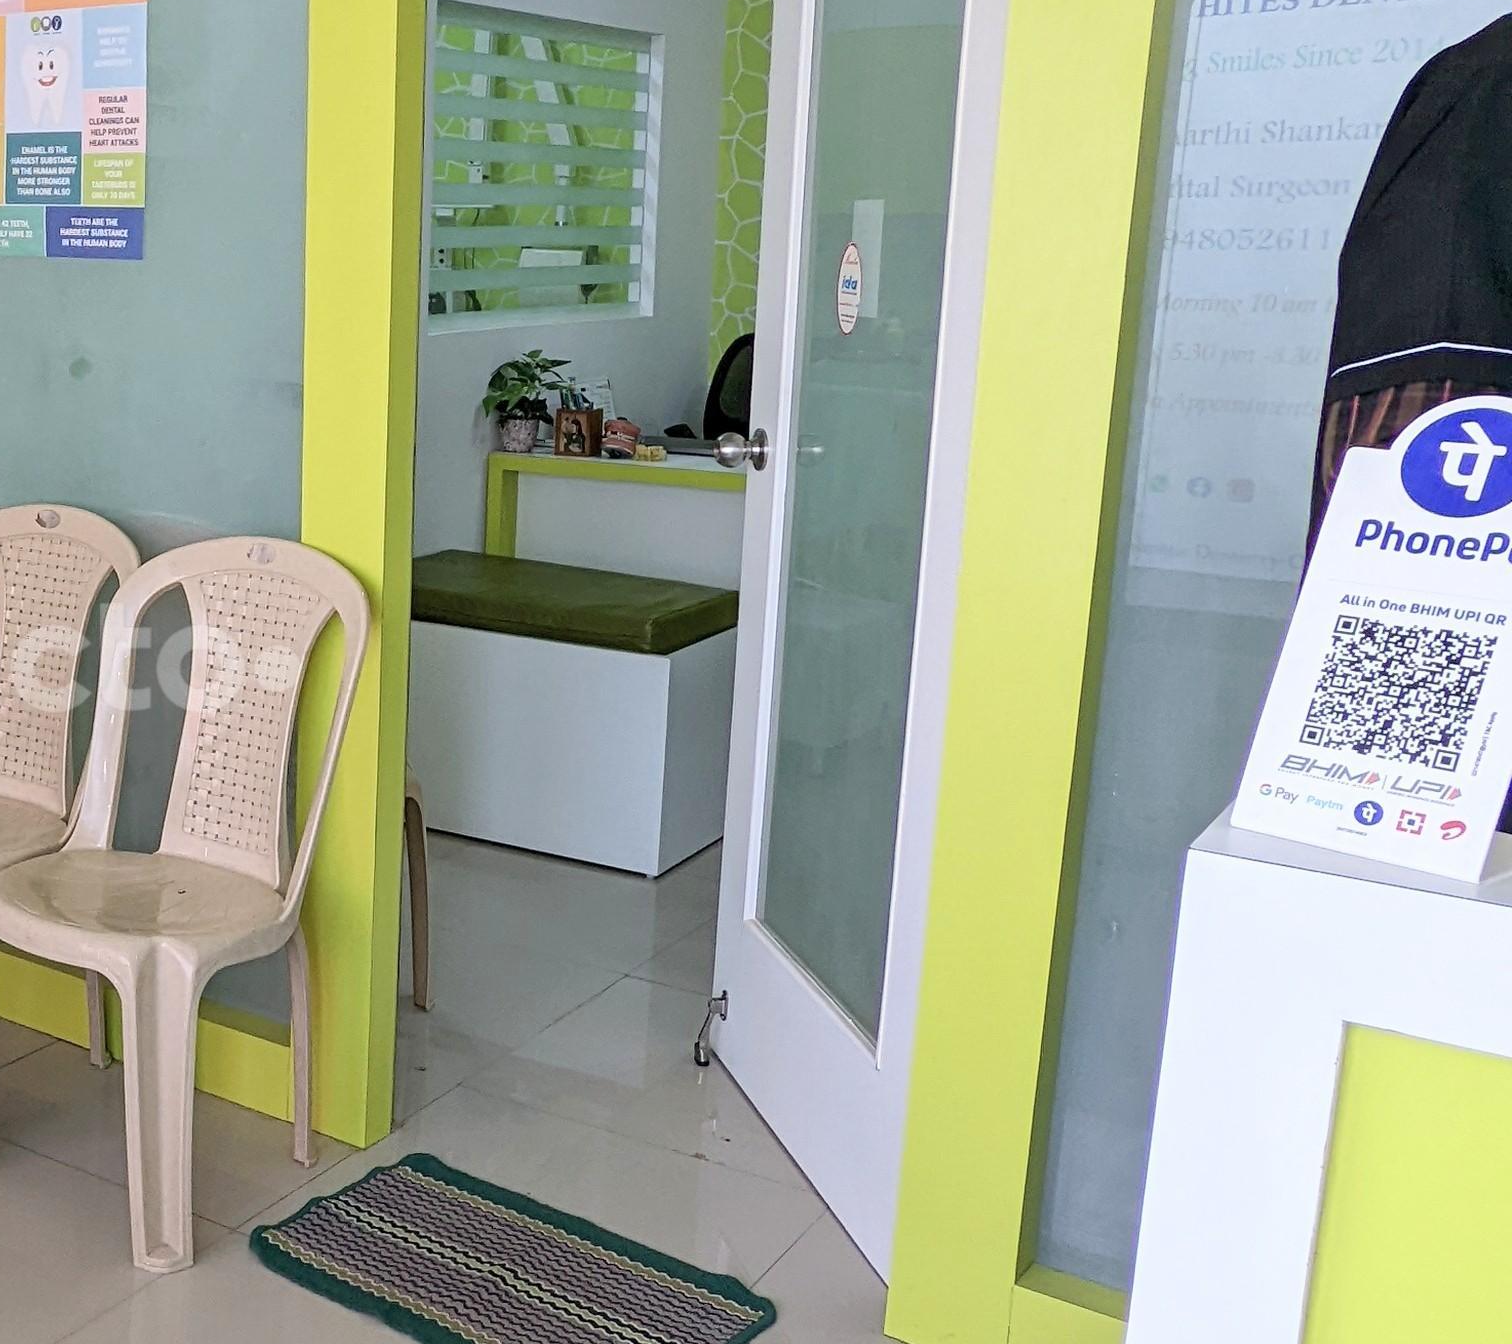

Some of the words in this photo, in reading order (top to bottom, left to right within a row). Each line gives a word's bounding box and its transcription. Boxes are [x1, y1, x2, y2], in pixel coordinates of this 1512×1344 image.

[1293, 43, 1363, 69] Since
[98, 95, 129, 104] REGULAR
[101, 106, 125, 114] DENTAL
[125, 116, 140, 124] CAN
[90, 128, 107, 137] HELP
[108, 127, 137, 136] PREVENT
[89, 139, 109, 147] HEART
[110, 138, 139, 147] ATTACKS
[21, 146, 46, 155] ENAMEL
[54, 145, 68, 154] THE
[10, 157, 39, 165] HARDEST
[40, 156, 78, 165] SUBSTANCE
[11, 167, 20, 176] IN
[20, 167, 32, 175] THE
[33, 166, 58, 175] HUMAN
[58, 166, 76, 175] BODY
[17, 177, 36, 186] MORE
[36, 177, 71, 186] STRONGER
[17, 187, 35, 196] THAN
[35, 187, 52, 196] BONE
[53, 187, 71, 196] ALSO
[1229, 175, 1351, 206] Surgeon
[70, 217, 91, 226] TEETH
[91, 217, 105, 226] ARE
[105, 217, 119, 226] THE
[59, 227, 90, 236] HARDEST
[90, 228, 129, 238] SUBSTANCE
[61, 238, 70, 247] IN
[70, 238, 83, 247] THE
[83, 238, 108, 247] HUMAN
[109, 238, 127, 248] BODY
[1355, 518, 1512, 563] PhoneP
[1340, 593, 1361, 607] All
[1362, 596, 1376, 609] in
[1378, 599, 1407, 613] One
[1409, 602, 1451, 619] BHIM
[1453, 609, 1482, 623] UPI
[1484, 613, 1508, 627] QR
[1279, 753, 1371, 785] BHIM
[1389, 775, 1454, 801] UPI
[1274, 786, 1300, 806] Pay
[1305, 794, 1344, 812] Paytm
